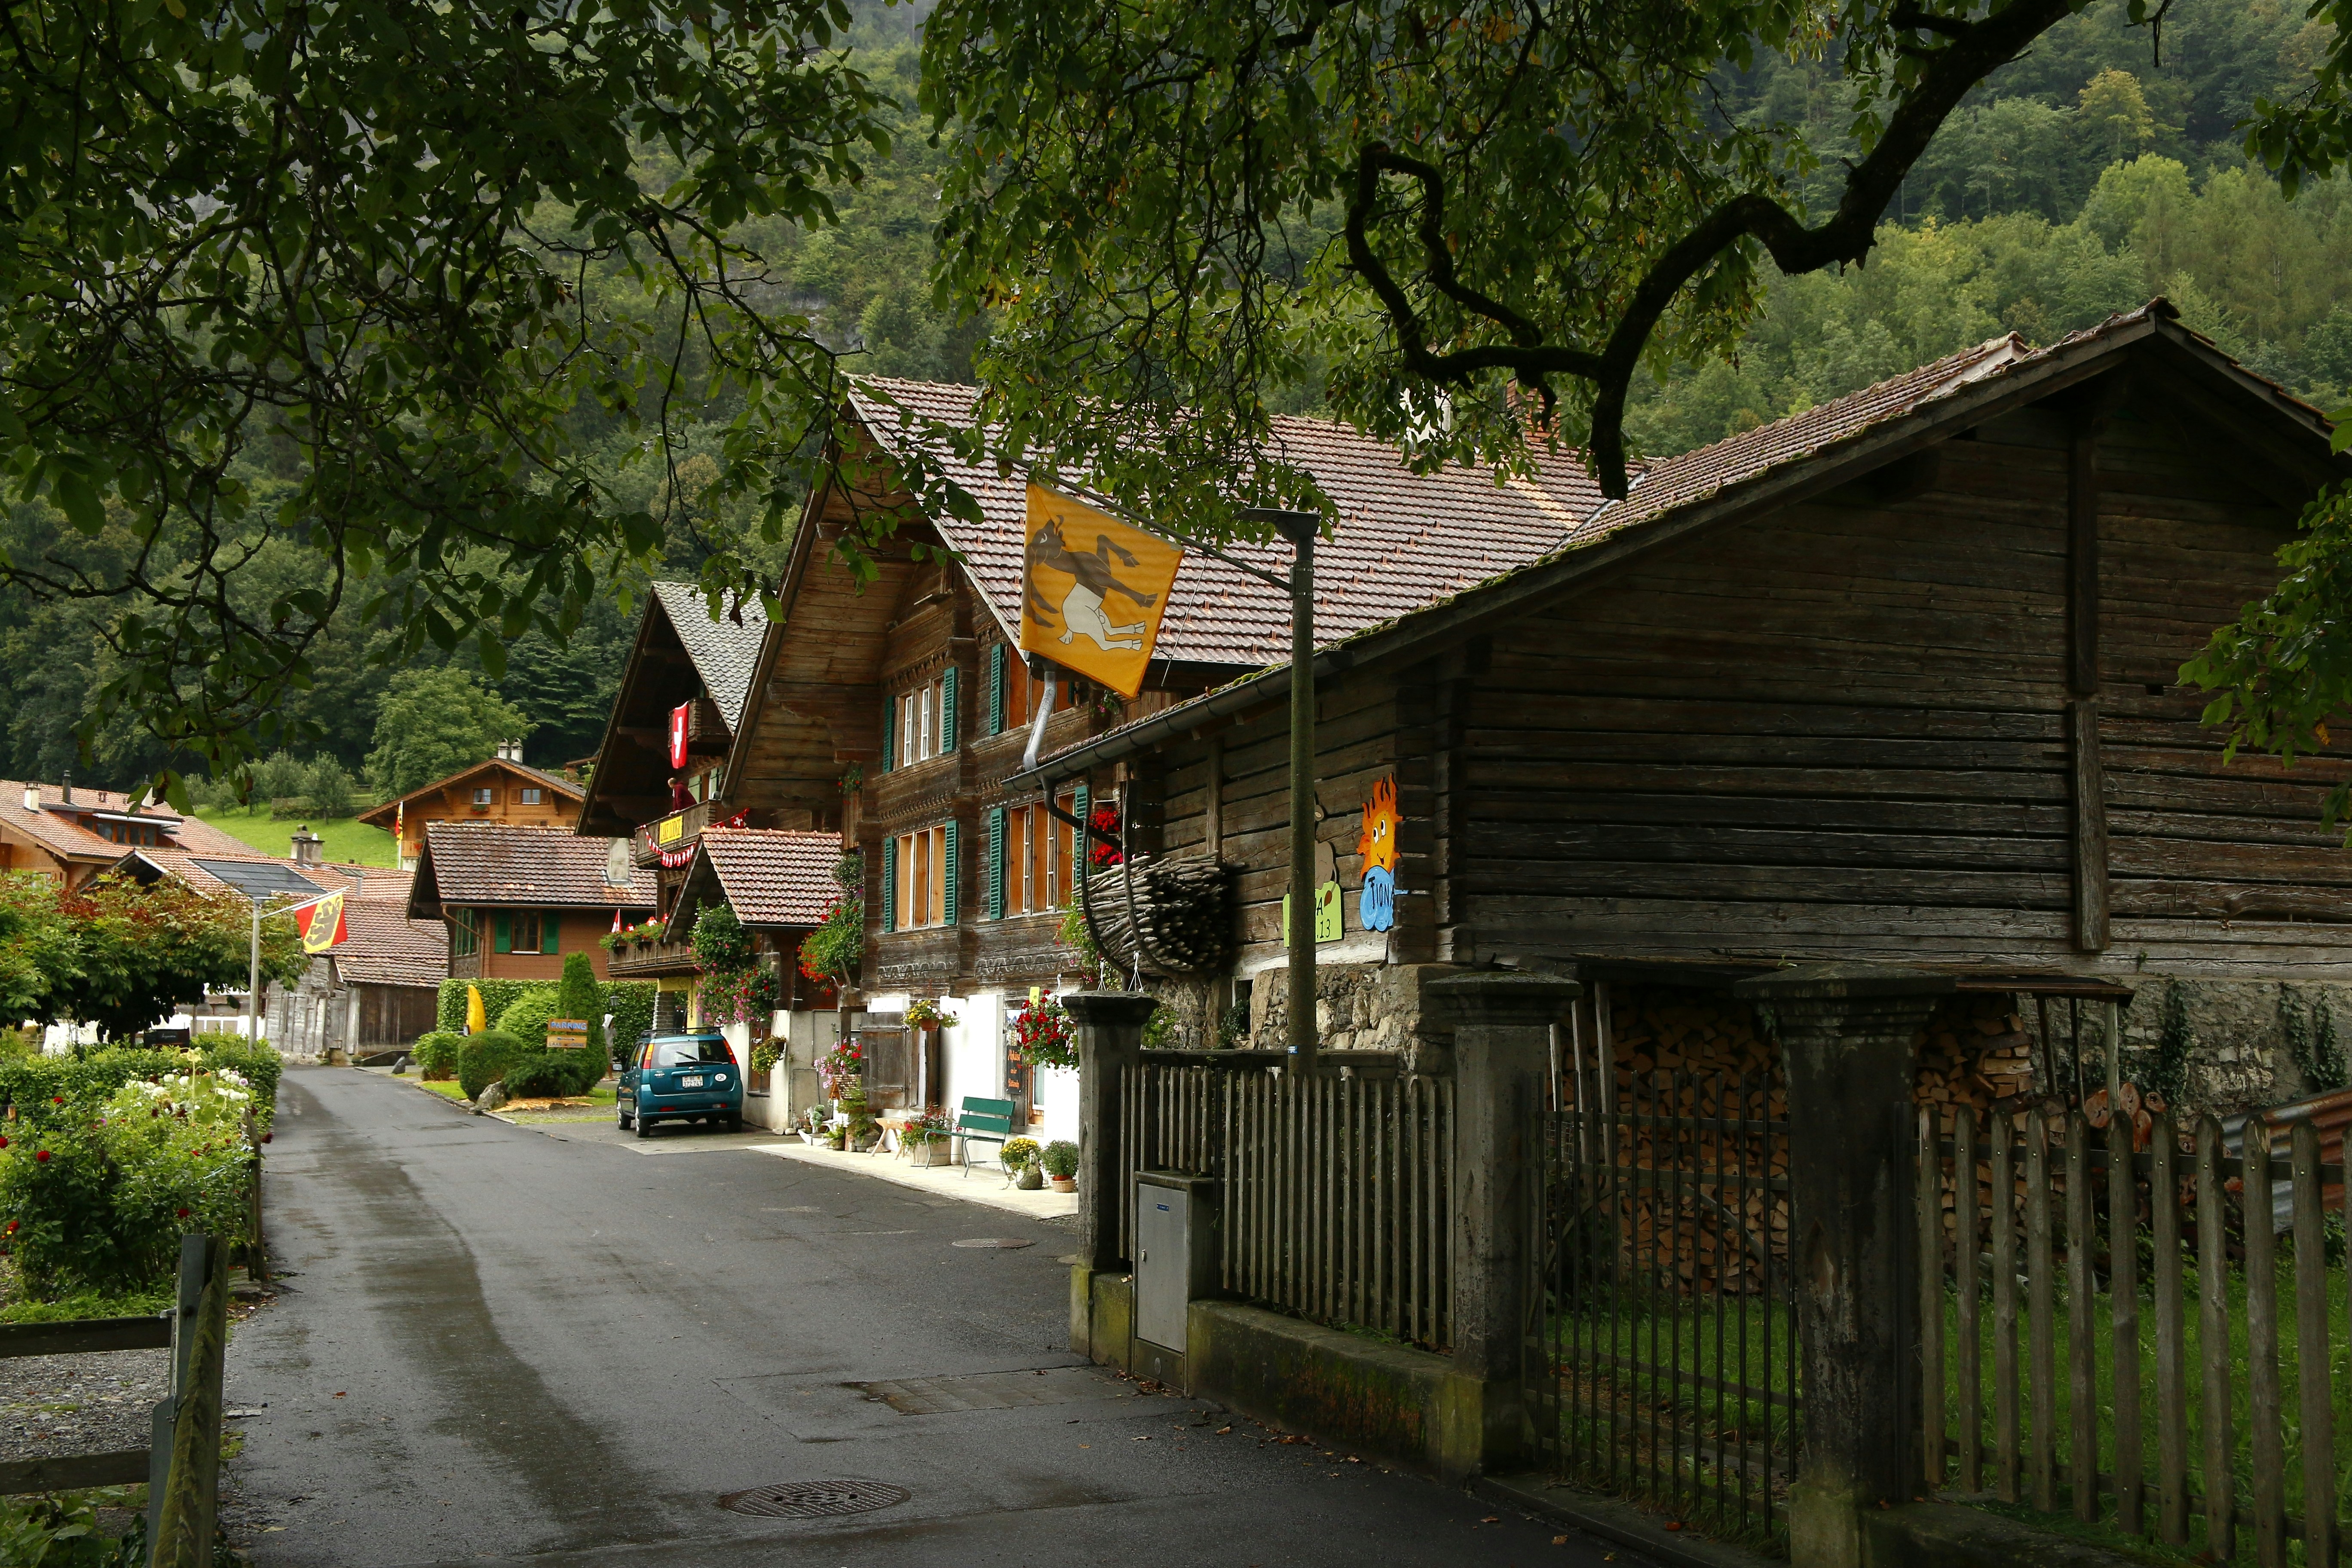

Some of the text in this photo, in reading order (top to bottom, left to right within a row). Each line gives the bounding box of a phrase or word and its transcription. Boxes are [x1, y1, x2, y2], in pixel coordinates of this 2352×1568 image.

[661, 819, 680, 841] LAKE LODGE
[551, 1022, 586, 1030] PARKING
